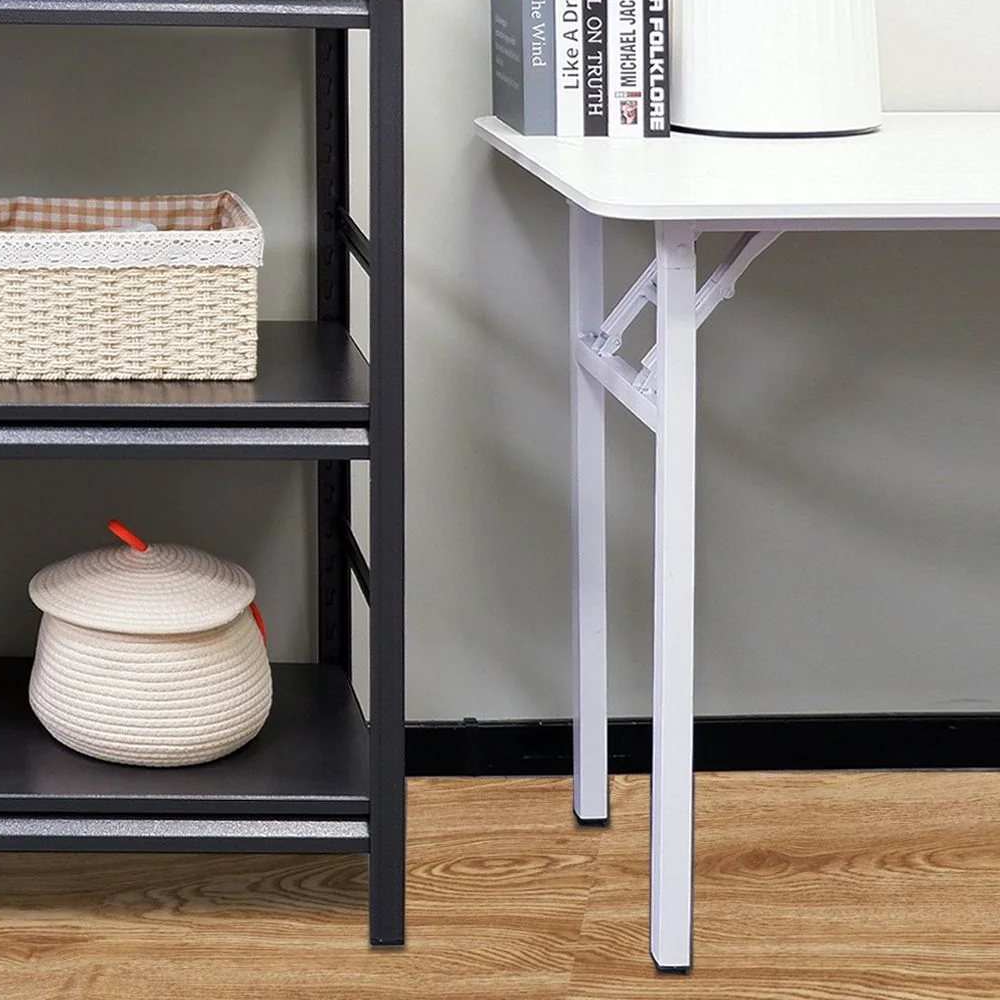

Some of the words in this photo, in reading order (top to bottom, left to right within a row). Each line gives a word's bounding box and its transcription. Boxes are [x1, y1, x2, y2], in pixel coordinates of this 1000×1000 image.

[531, 23, 547, 68] Wind
[564, 28, 579, 42] A
[586, 16, 602, 43] ON
[562, 47, 579, 90] Like
[620, 29, 637, 87] MICHAEL
[648, 17, 665, 132] FOLKLORE
[587, 50, 603, 116] TRUTH
